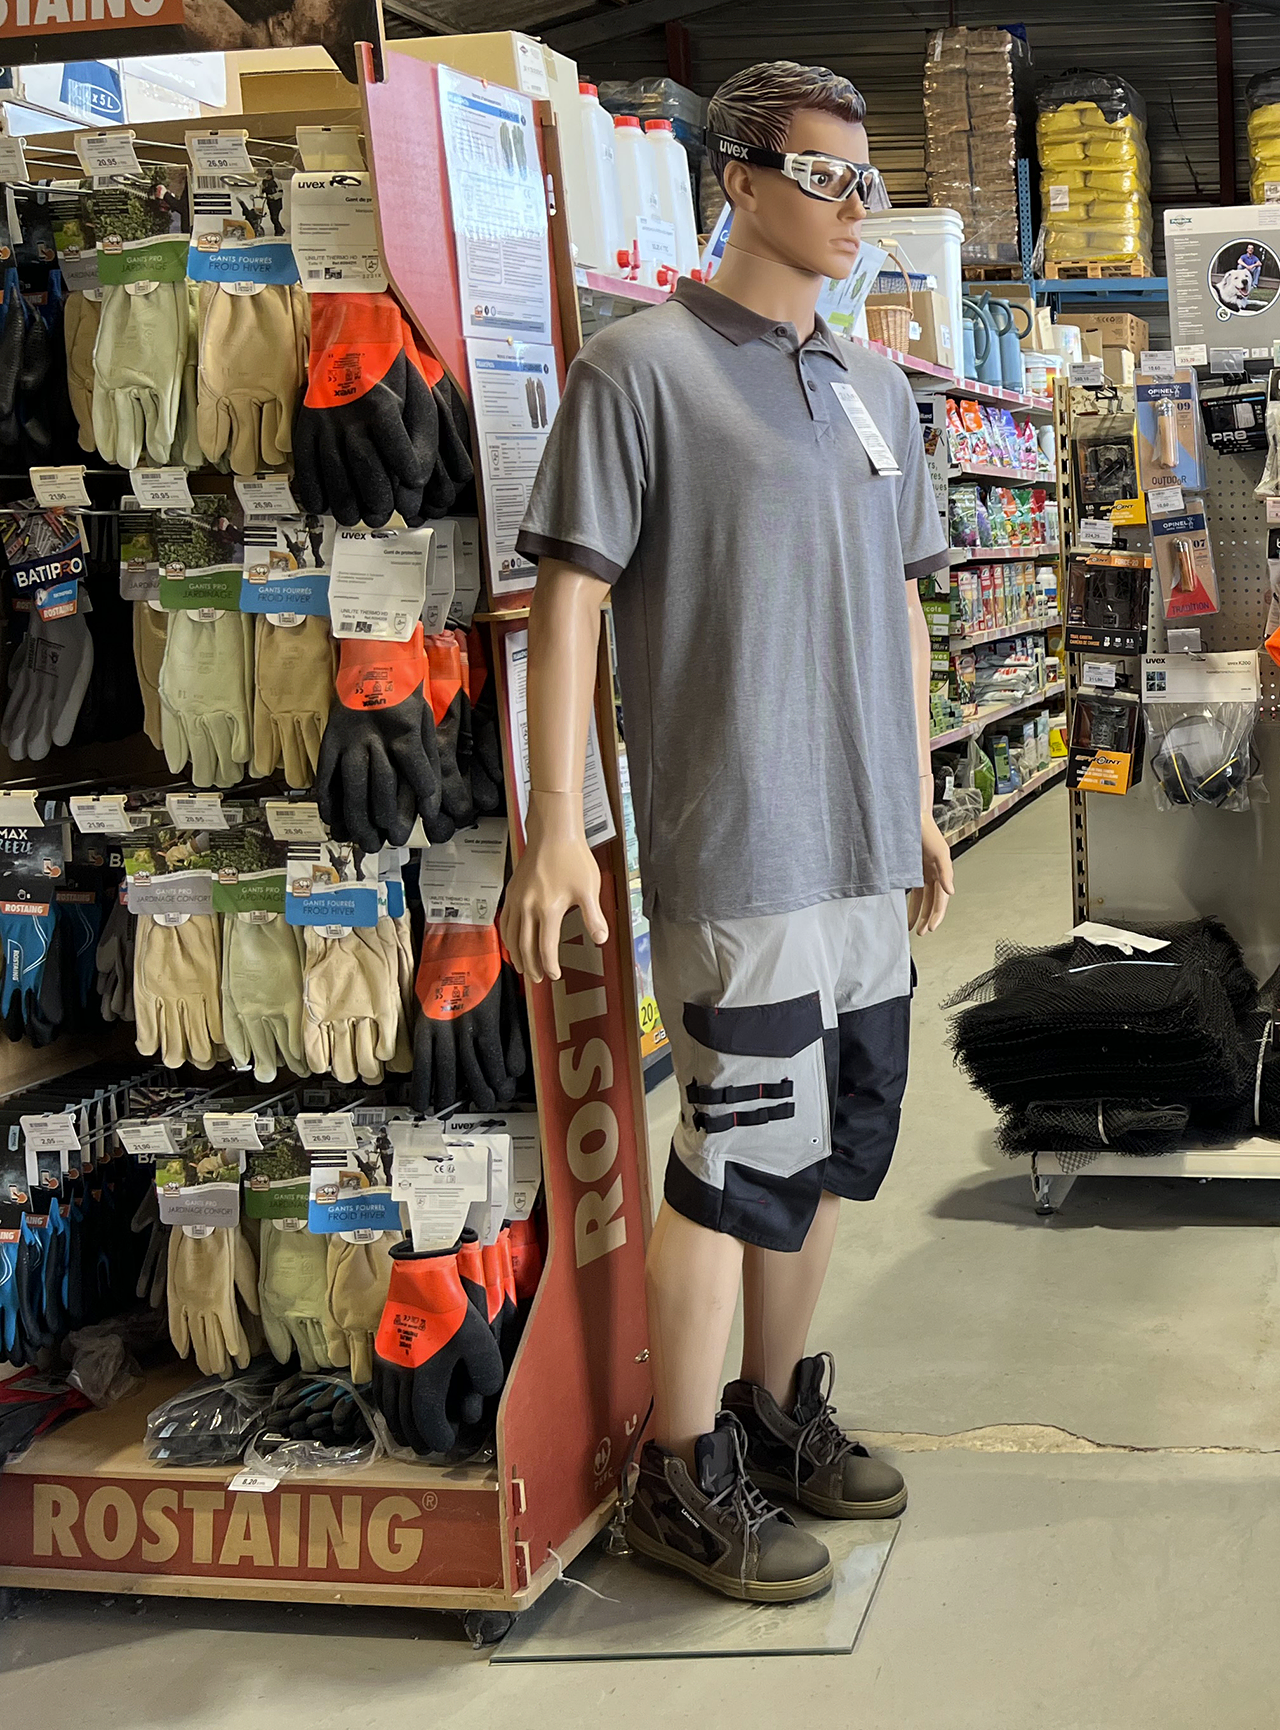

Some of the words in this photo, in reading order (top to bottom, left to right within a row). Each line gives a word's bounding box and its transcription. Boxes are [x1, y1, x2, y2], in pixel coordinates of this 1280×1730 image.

[720, 139, 749, 160] uvex
[297, 180, 326, 189] uvex
[209, 255, 236, 263] GANTS
[238, 256, 273, 264] FOURRÉS
[121, 262, 168, 272] JARDINAGE
[208, 262, 240, 272] FROID
[242, 263, 271, 272] HIVER
[1176, 402, 1191, 410] 09
[1151, 476, 1187, 486] OUTDOOR
[1162, 520, 1189, 529] OPINEL
[341, 532, 367, 541] uvex
[1193, 539, 1206, 548] 07
[16, 557, 82, 588] BATIPRO
[182, 589, 234, 600] JARDINAGE
[280, 586, 312, 594] FOURRÉS
[257, 594, 282, 603] FROID
[285, 595, 312, 603] HIVER
[43, 603, 74, 619] ROSTAING
[1171, 602, 1210, 614] TRADITION
[1145, 657, 1166, 665] uvex
[136, 894, 176, 903] JARDINAGE
[176, 894, 211, 903] CONFORT
[303, 899, 325, 908] GANTS
[326, 899, 356, 908] FOURRÉS
[4, 903, 44, 914] ROSTAING
[302, 907, 328, 916] FROID
[330, 907, 355, 916] HIVER
[12, 949, 21, 982] ROSTAING
[640, 1003, 654, 1026] 20
[450, 1121, 475, 1130] uvex
[273, 1193, 293, 1201] GANTS
[167, 1207, 202, 1215] JARDINAGE
[203, 1207, 234, 1216] CONFORT
[327, 1204, 354, 1213] GANTS
[355, 1204, 386, 1213] FOURRÉS
[327, 1211, 358, 1221] FROID
[359, 1211, 386, 1221] HIVER
[242, 1477, 258, 1487] 8,20
[33, 1483, 425, 1574] ROSTAING
